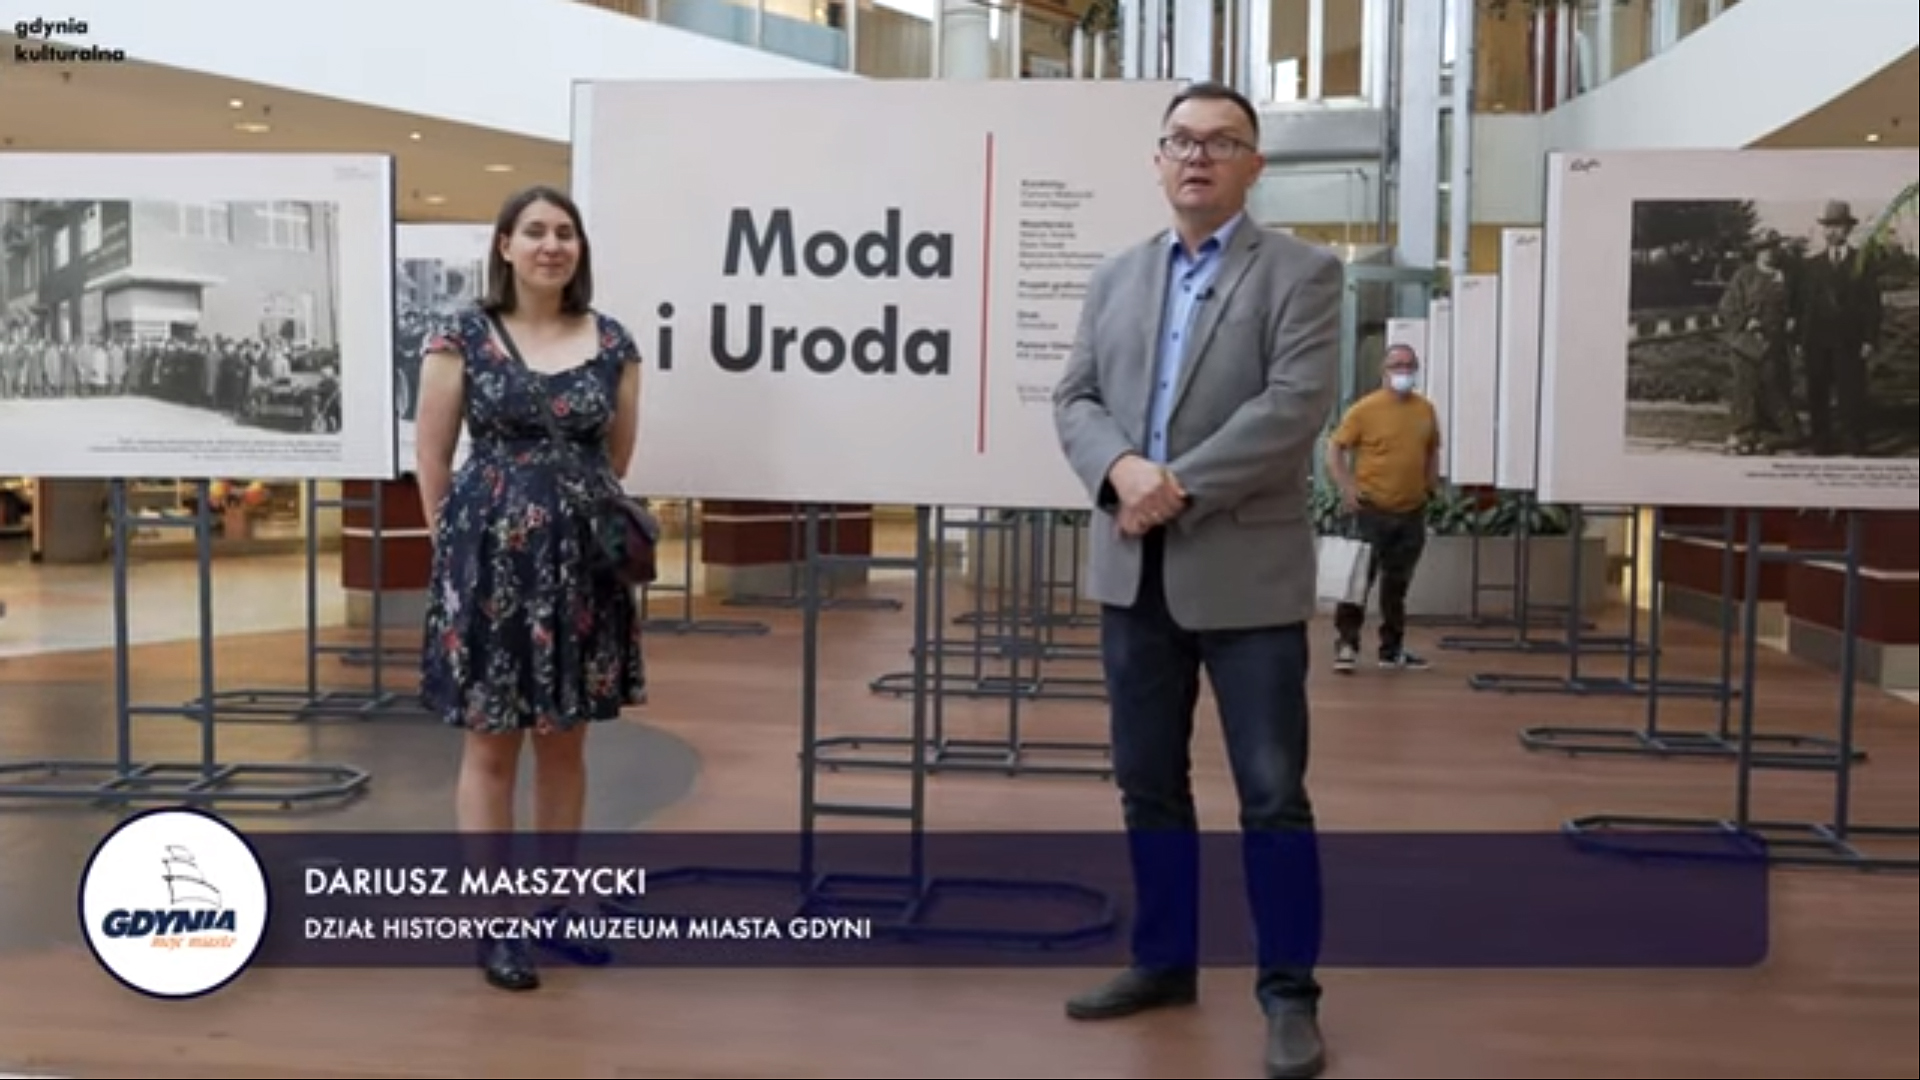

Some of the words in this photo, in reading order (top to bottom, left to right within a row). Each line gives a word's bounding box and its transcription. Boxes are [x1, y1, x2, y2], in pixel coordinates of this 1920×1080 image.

[723, 207, 954, 279] Moda
[657, 302, 675, 371] i
[710, 304, 951, 376] Uroda
